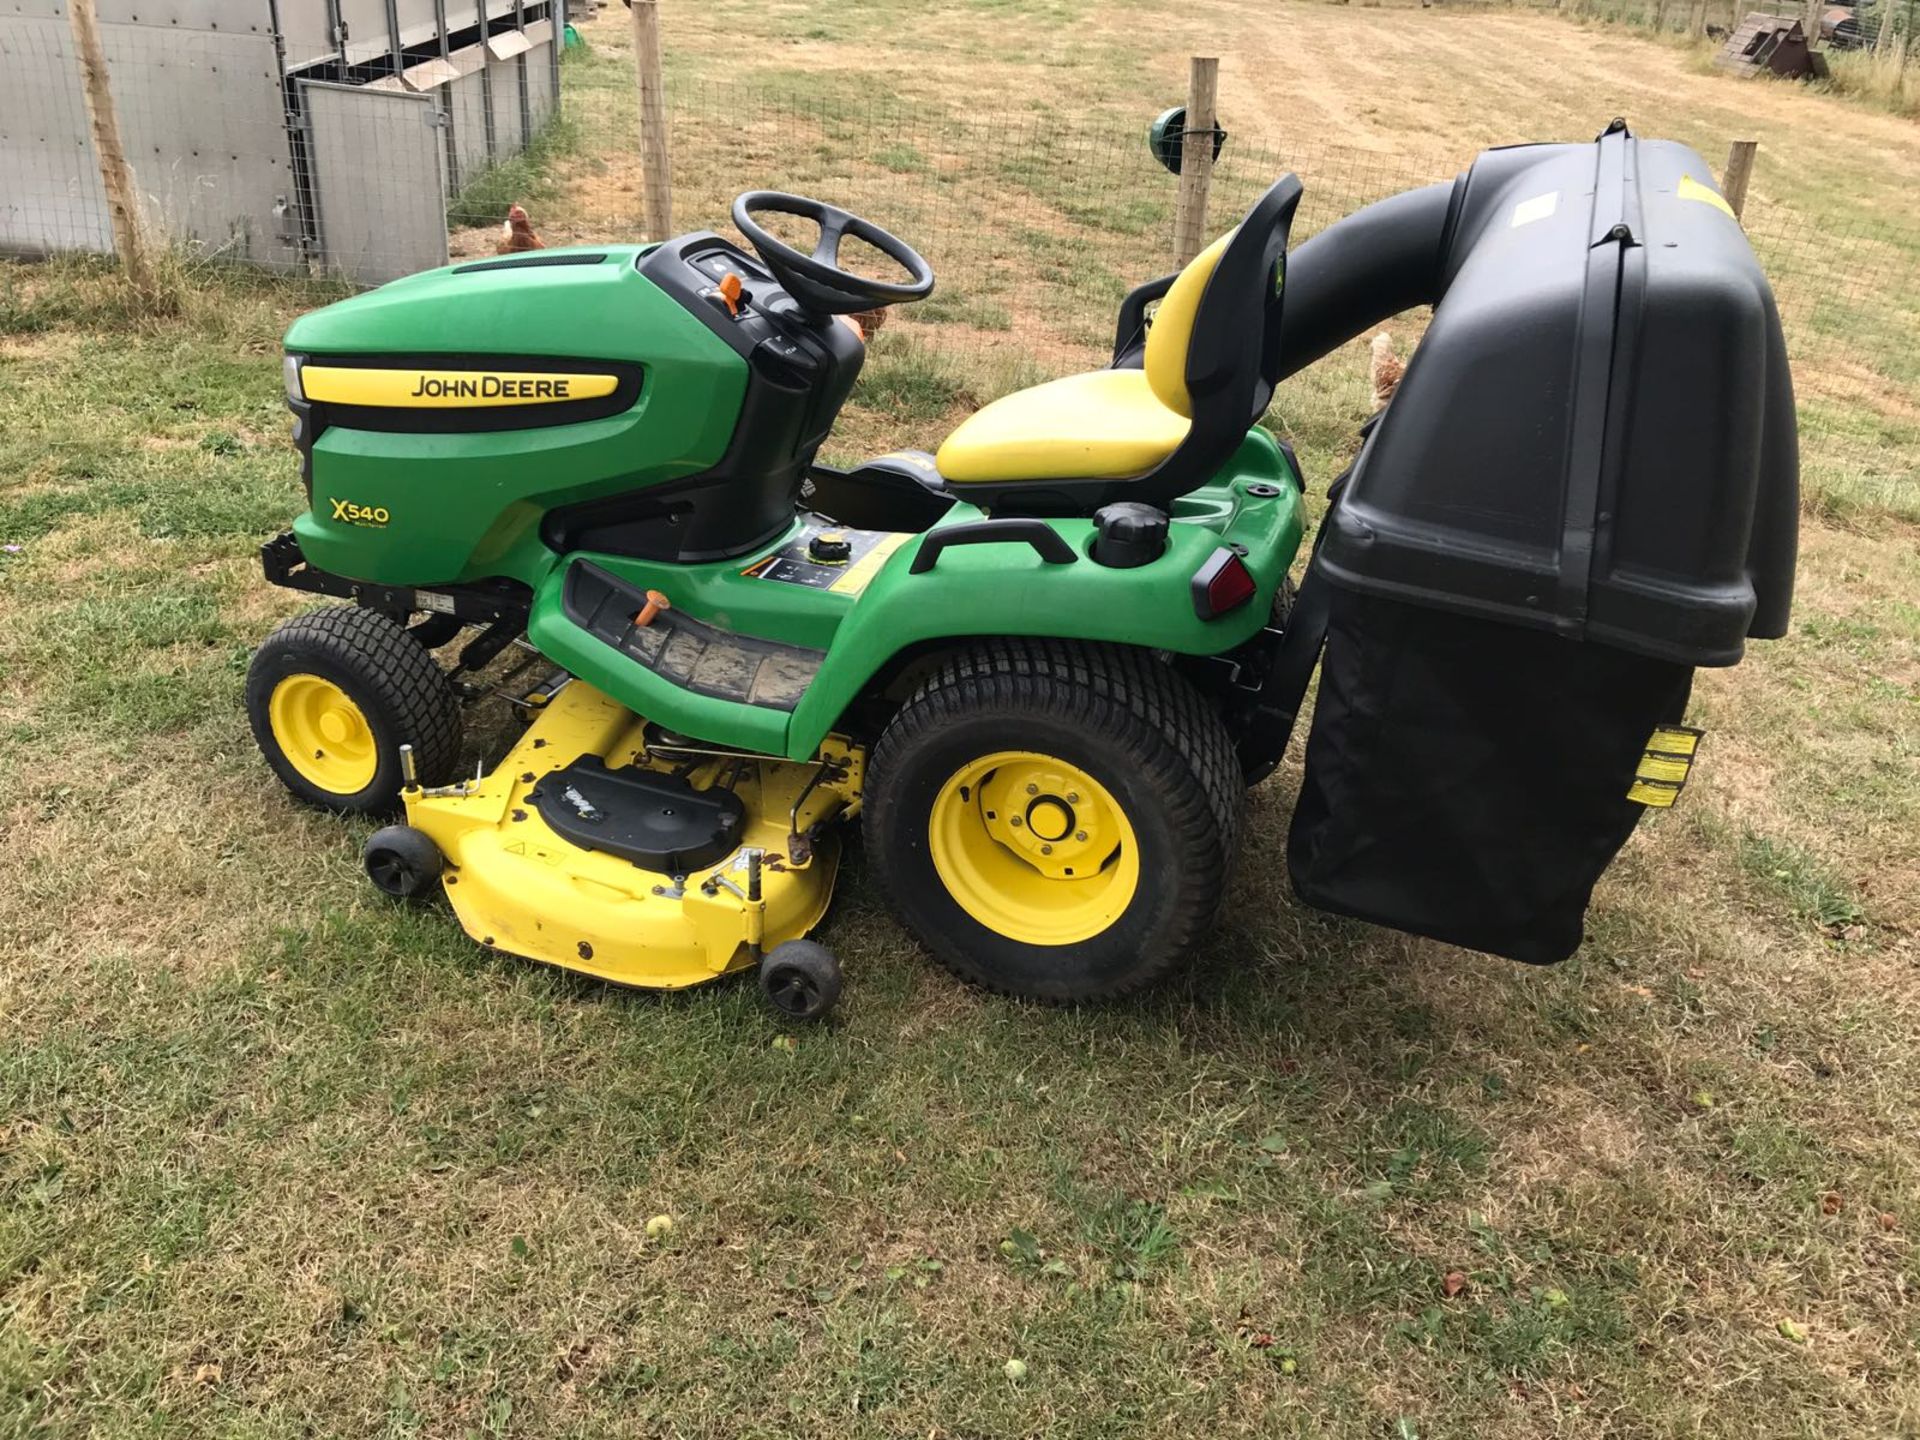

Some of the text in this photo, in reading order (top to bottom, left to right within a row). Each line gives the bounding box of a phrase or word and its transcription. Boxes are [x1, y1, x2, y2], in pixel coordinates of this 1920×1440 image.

[411, 375, 570, 398] JOHN DEERE
[329, 497, 390, 523] X540
